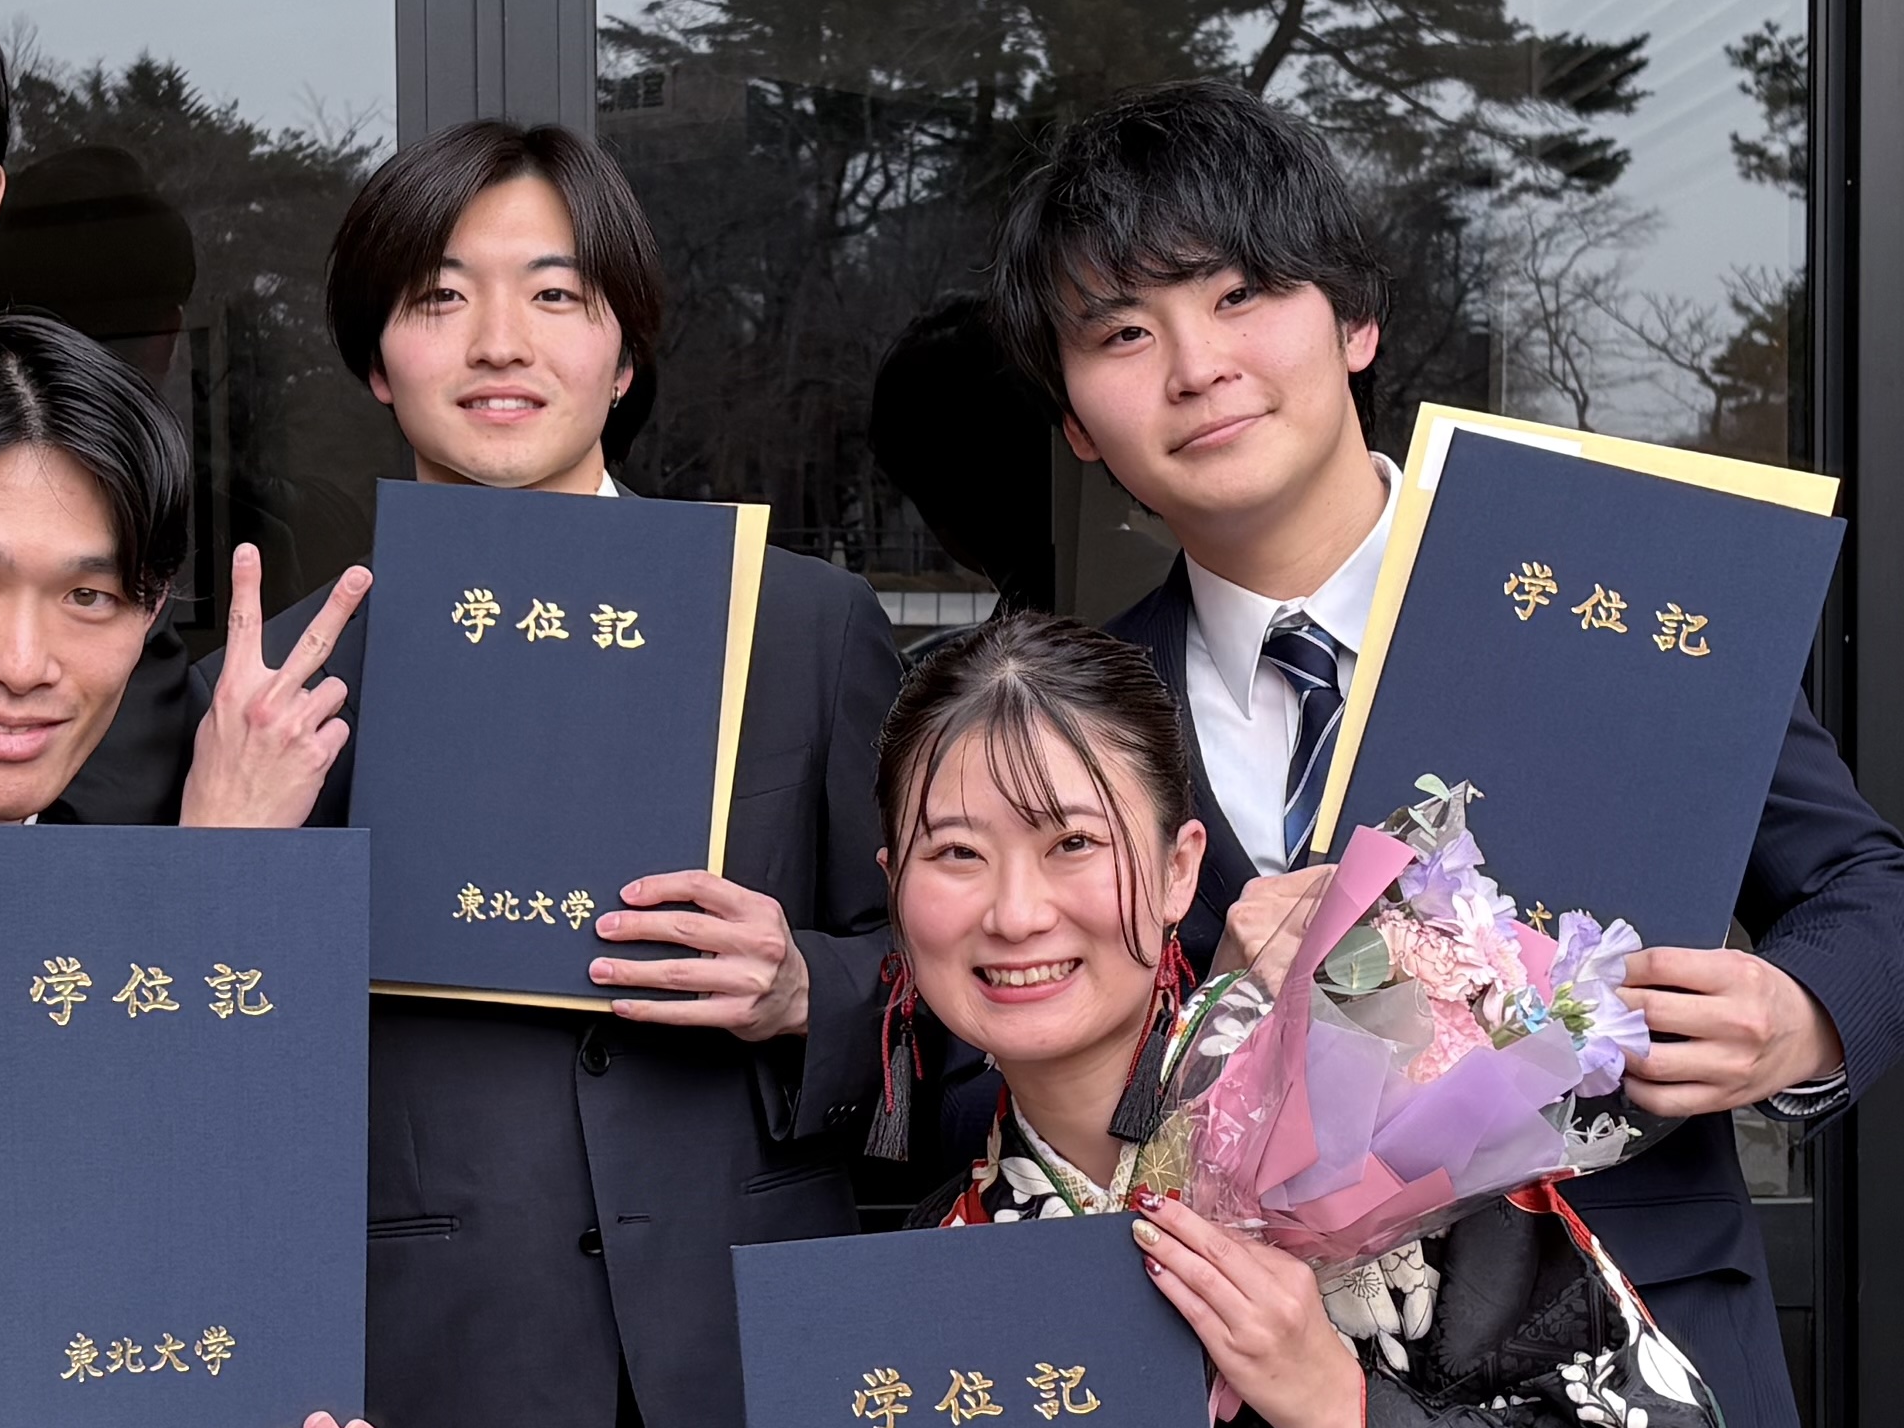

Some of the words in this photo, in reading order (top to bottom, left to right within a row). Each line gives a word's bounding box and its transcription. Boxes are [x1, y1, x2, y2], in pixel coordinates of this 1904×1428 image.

[451, 588, 646, 649] 学位記
[1503, 560, 1712, 657] 学位記
[452, 882, 595, 930] 東北大学
[29, 956, 276, 1026] 学位記
[60, 1325, 236, 1383] 東北大学
